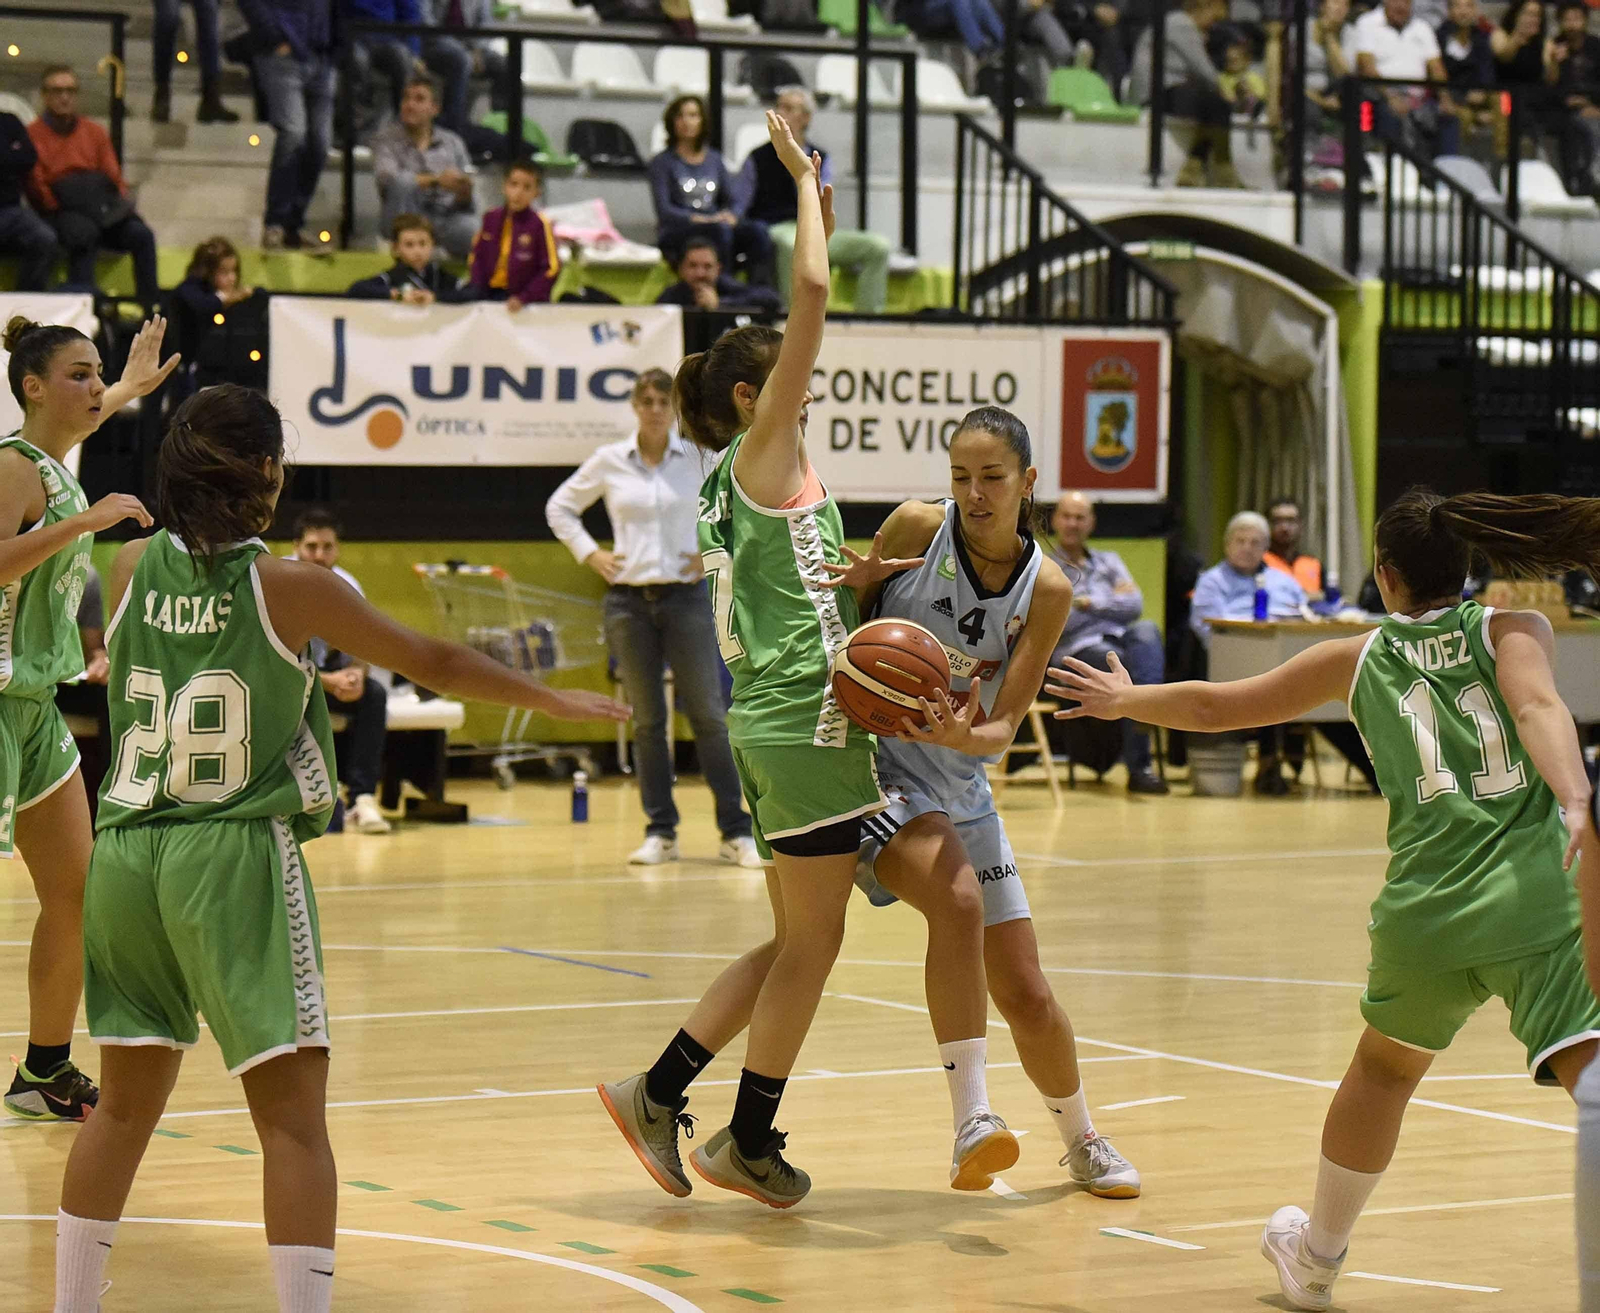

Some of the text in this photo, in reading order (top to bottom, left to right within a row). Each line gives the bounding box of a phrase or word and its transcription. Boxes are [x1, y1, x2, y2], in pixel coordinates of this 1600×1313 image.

[809, 368, 1018, 405] CONCELLO
[415, 415, 486, 437] ÓPTICA
[829, 417, 881, 452] DE
[930, 603, 955, 619] adidas
[957, 606, 987, 648] 4
[946, 651, 972, 668] ELLO
[103, 665, 252, 810] 28
[1398, 678, 1528, 804] 11
[1306, 1281, 1329, 1294] NIKE
